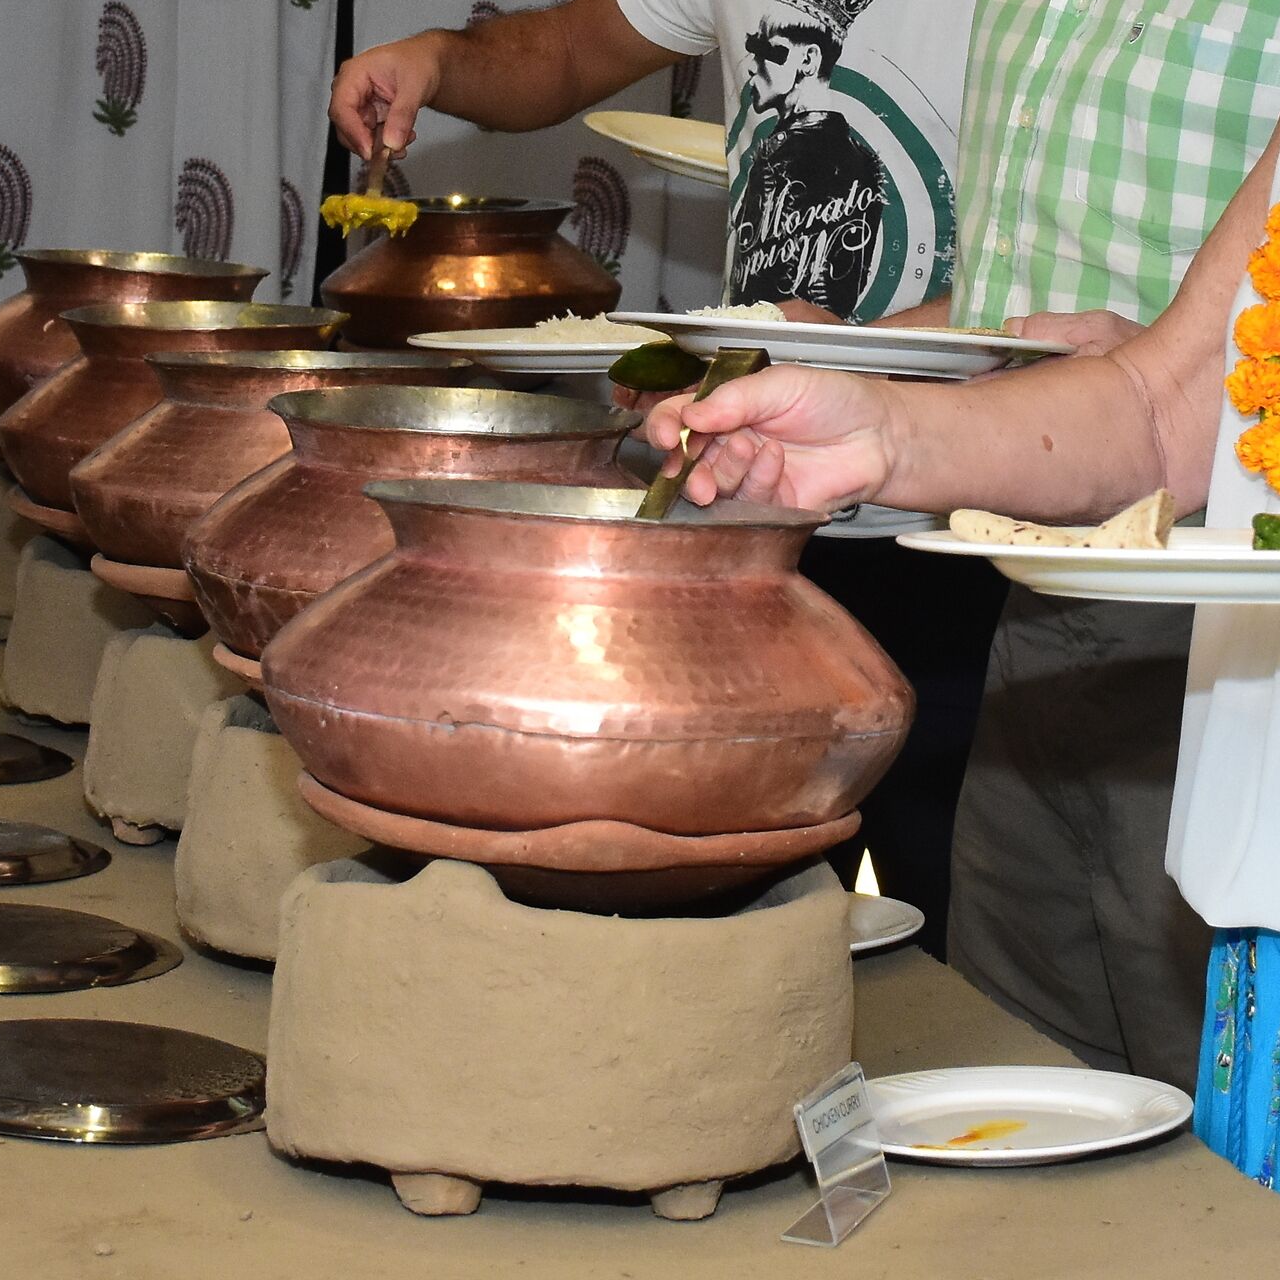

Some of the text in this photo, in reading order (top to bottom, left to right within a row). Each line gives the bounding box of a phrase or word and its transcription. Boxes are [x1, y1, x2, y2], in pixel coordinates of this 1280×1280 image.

[738, 179, 878, 253] Morato
[917, 242, 927, 255] 6
[813, 1094, 860, 1134] CHICKEN CURRY
